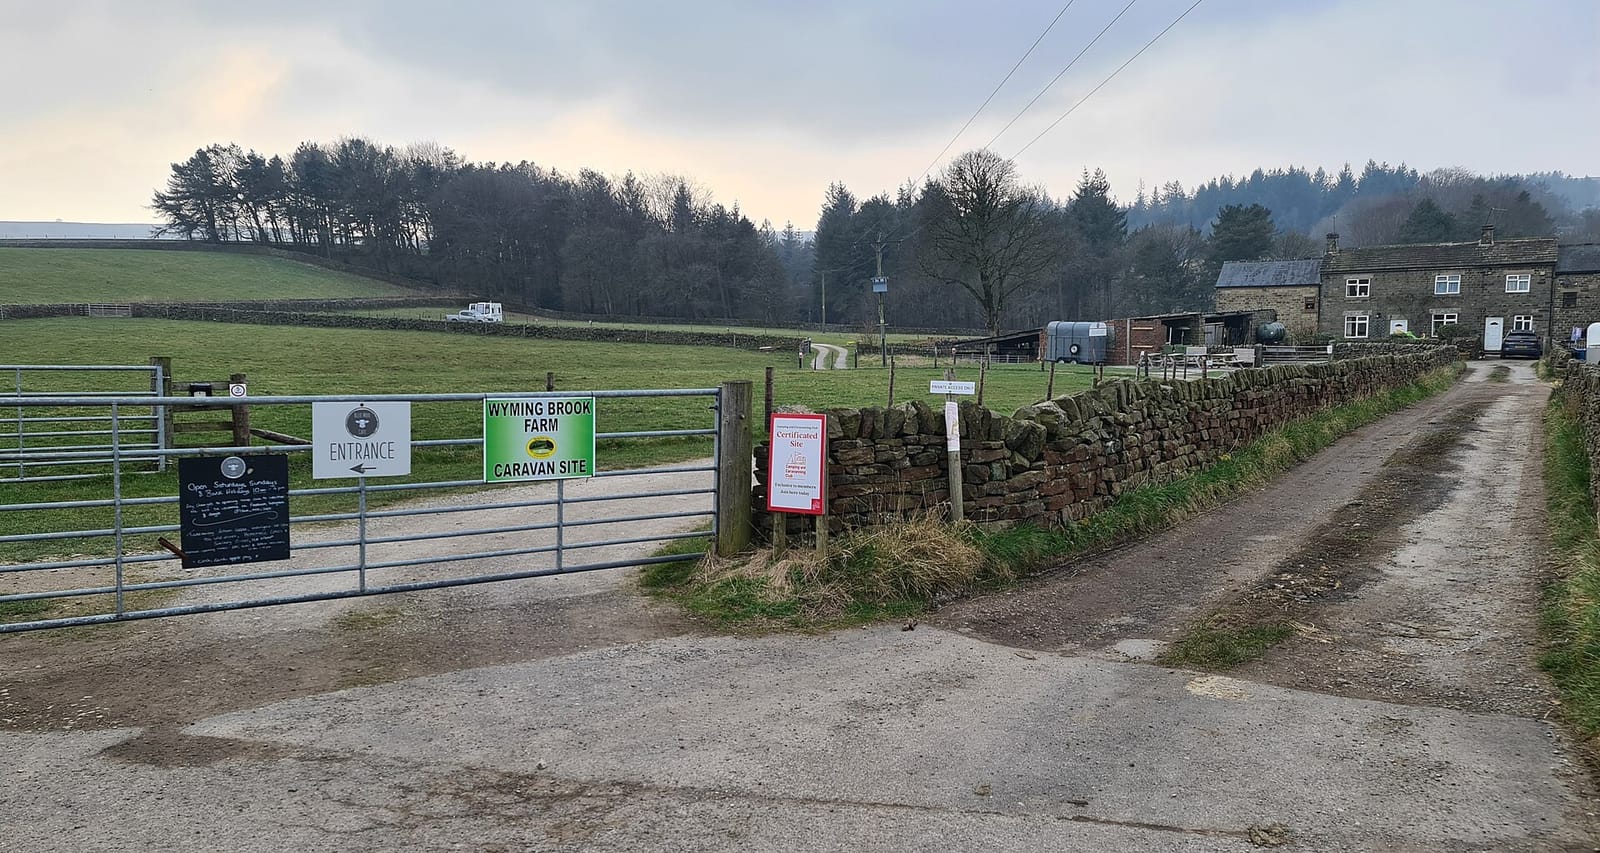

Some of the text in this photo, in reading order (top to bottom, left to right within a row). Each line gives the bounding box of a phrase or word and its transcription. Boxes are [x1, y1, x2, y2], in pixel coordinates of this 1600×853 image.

[489, 401, 591, 417] WYMING BROOK
[524, 418, 559, 432] FARM
[776, 431, 818, 439] Certificated
[330, 441, 395, 461] ENTRANCE
[790, 440, 804, 448] Site
[494, 459, 586, 478] CARAVAN SITE
[187, 483, 208, 492] Open
